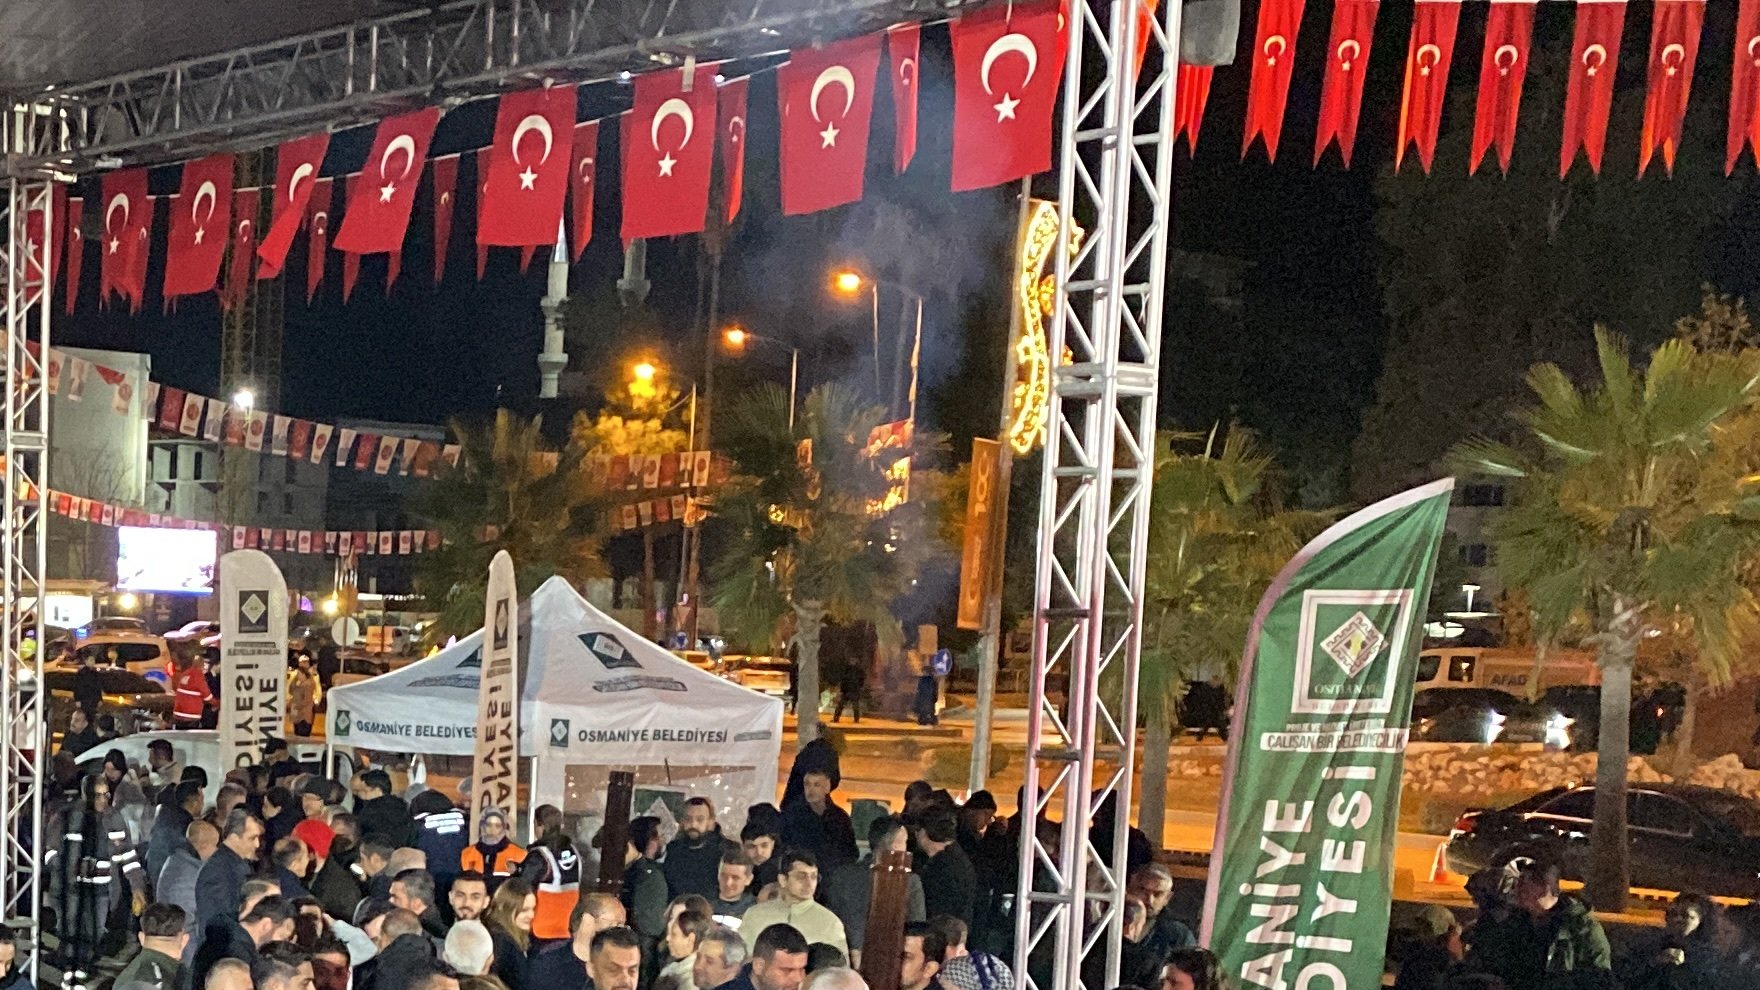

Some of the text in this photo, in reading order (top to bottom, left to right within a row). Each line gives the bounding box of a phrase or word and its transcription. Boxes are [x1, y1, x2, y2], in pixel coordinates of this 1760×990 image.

[356, 720, 411, 736] OSMANİYE
[578, 728, 649, 742] OSMANİYE
[652, 728, 728, 743] BELEDİYESİ
